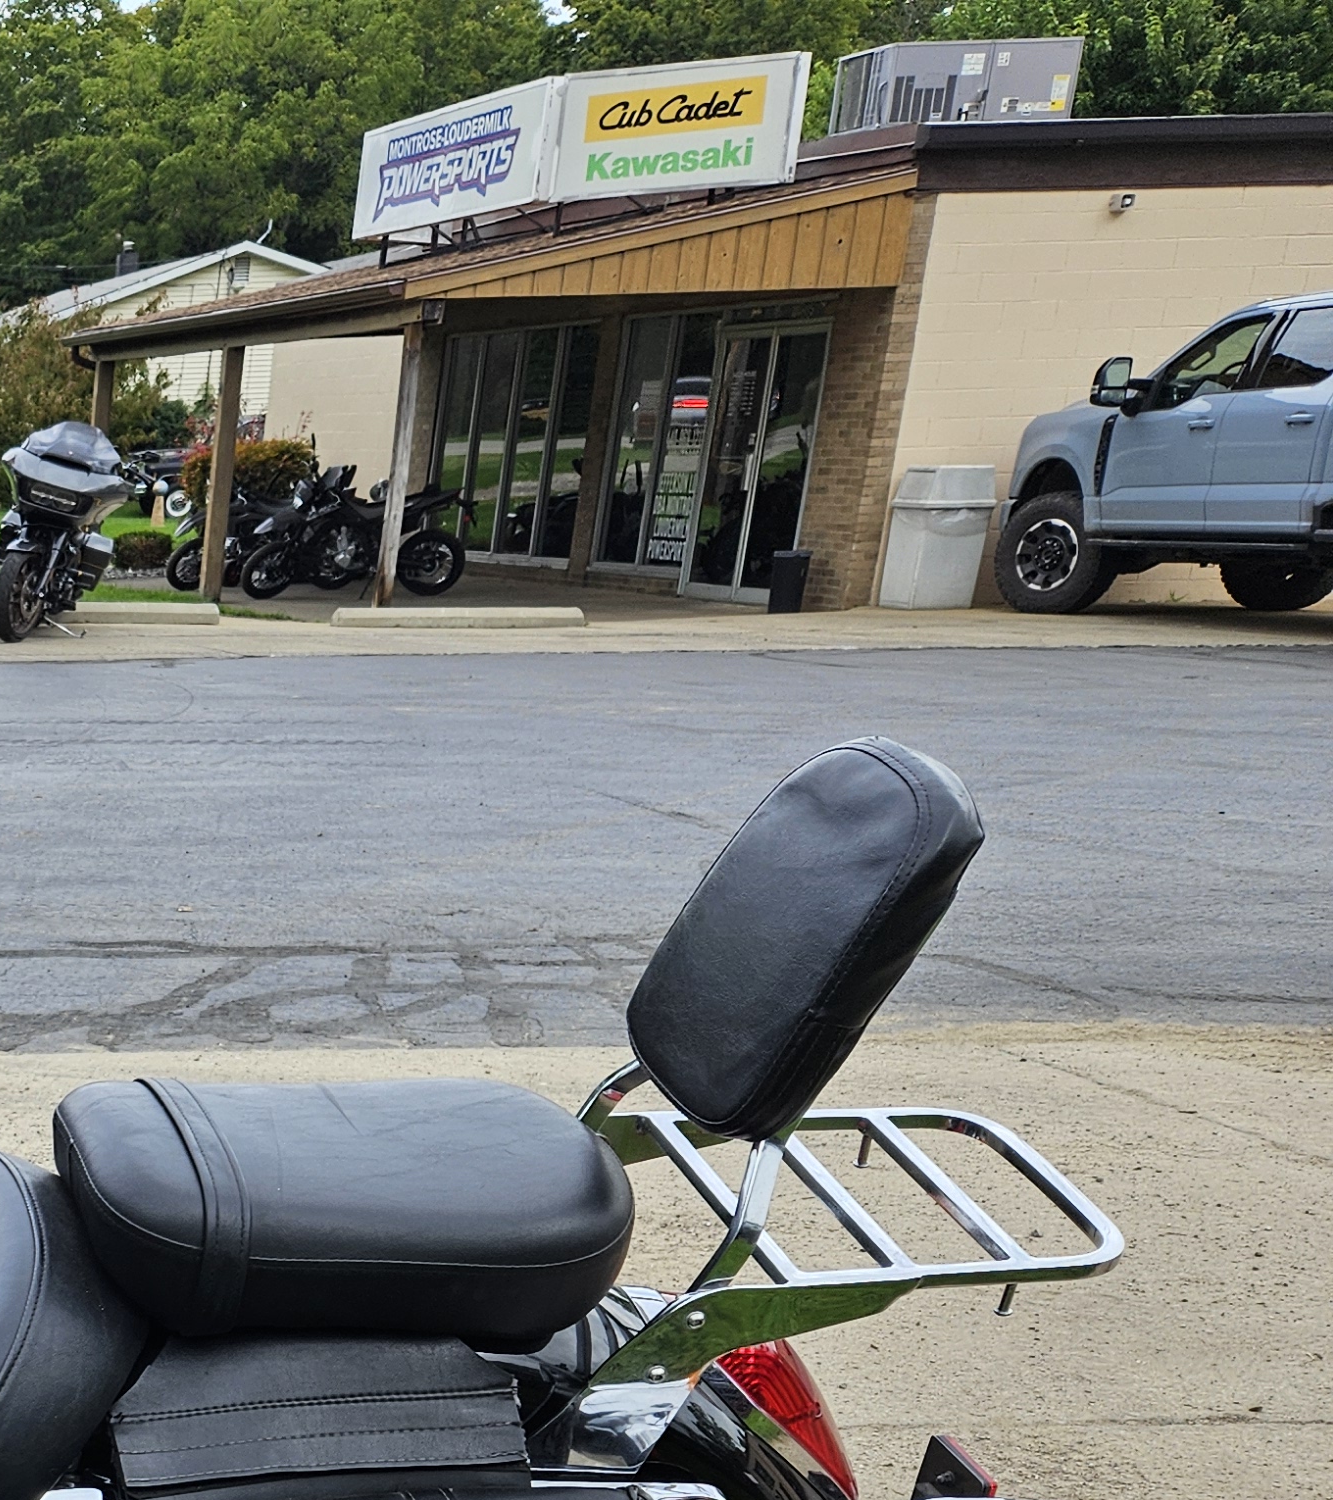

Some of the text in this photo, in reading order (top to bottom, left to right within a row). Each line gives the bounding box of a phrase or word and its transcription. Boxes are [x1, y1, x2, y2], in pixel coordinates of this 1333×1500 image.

[388, 105, 513, 163] MONTROSE-LOUDERMILK
[599, 87, 753, 130] Cub Cadet
[376, 135, 518, 211] POWERSPORTS
[585, 137, 755, 182] Kawasaki
